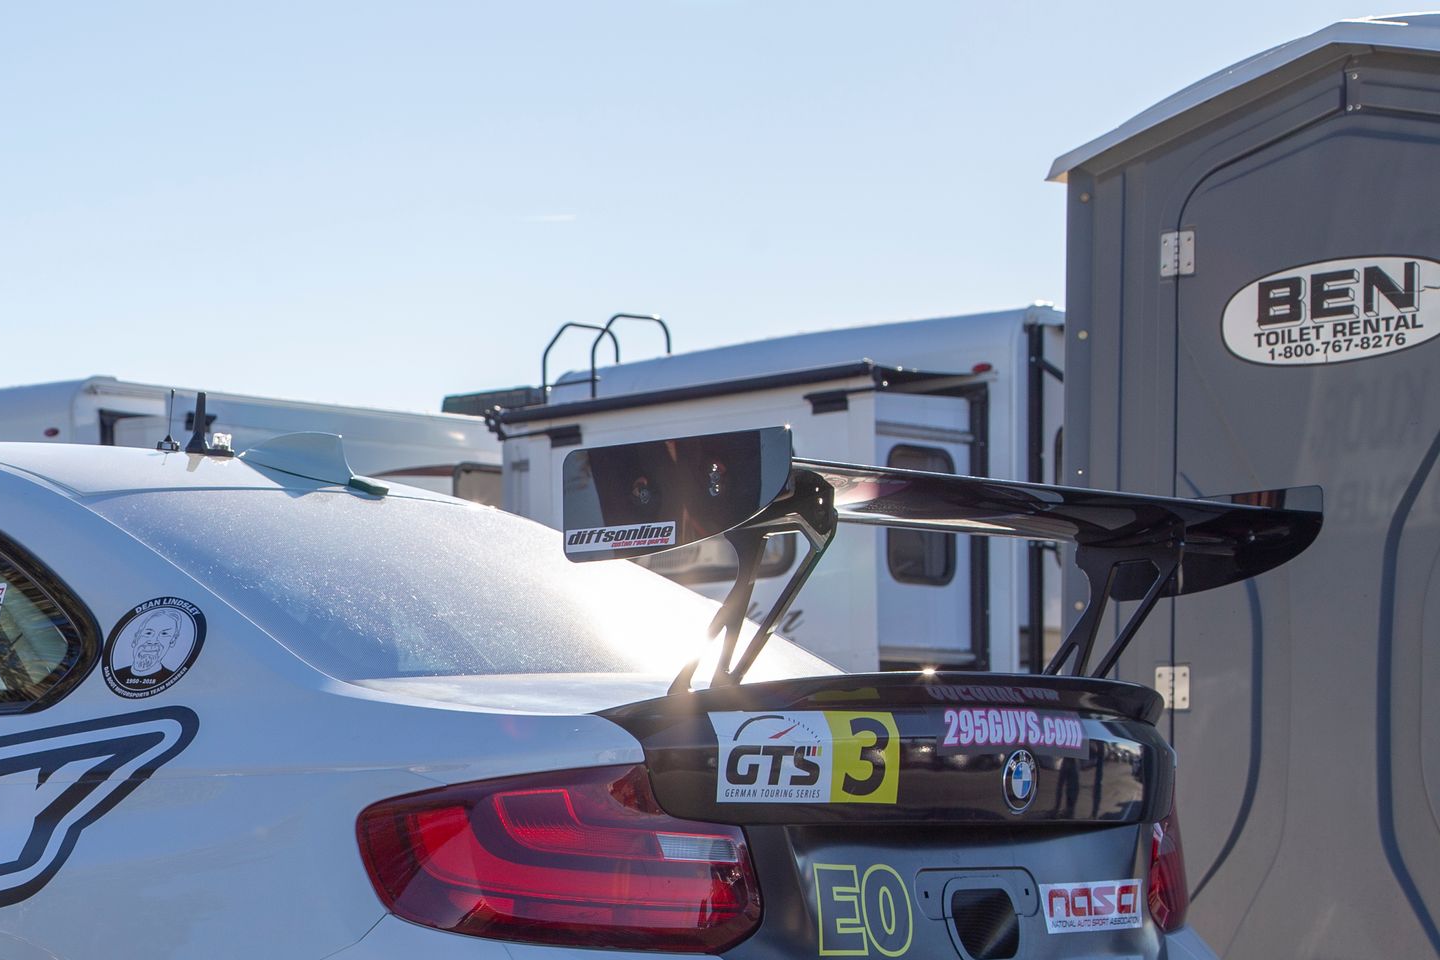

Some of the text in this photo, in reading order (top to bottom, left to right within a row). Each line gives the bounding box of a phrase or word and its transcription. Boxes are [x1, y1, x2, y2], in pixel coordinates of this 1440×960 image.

[1257, 261, 1420, 330] BEN
[1254, 314, 1423, 348] TOILET RENTAL
[1268, 332, 1407, 361] 1-800-767-8276
[567, 524, 674, 546] diffsonline
[135, 598, 200, 616] DEAN LINDSLEY
[150, 685, 166, 695] TEAM
[165, 666, 187, 688] MEMBER
[942, 707, 1082, 748] 295GUYS.com
[725, 744, 822, 786] GTS
[841, 717, 889, 796] 3
[724, 788, 820, 799] GERMAN TOURING SERIES
[1051, 916, 1138, 929] NATIONAL AUTO SPORT ASSOCIATION
